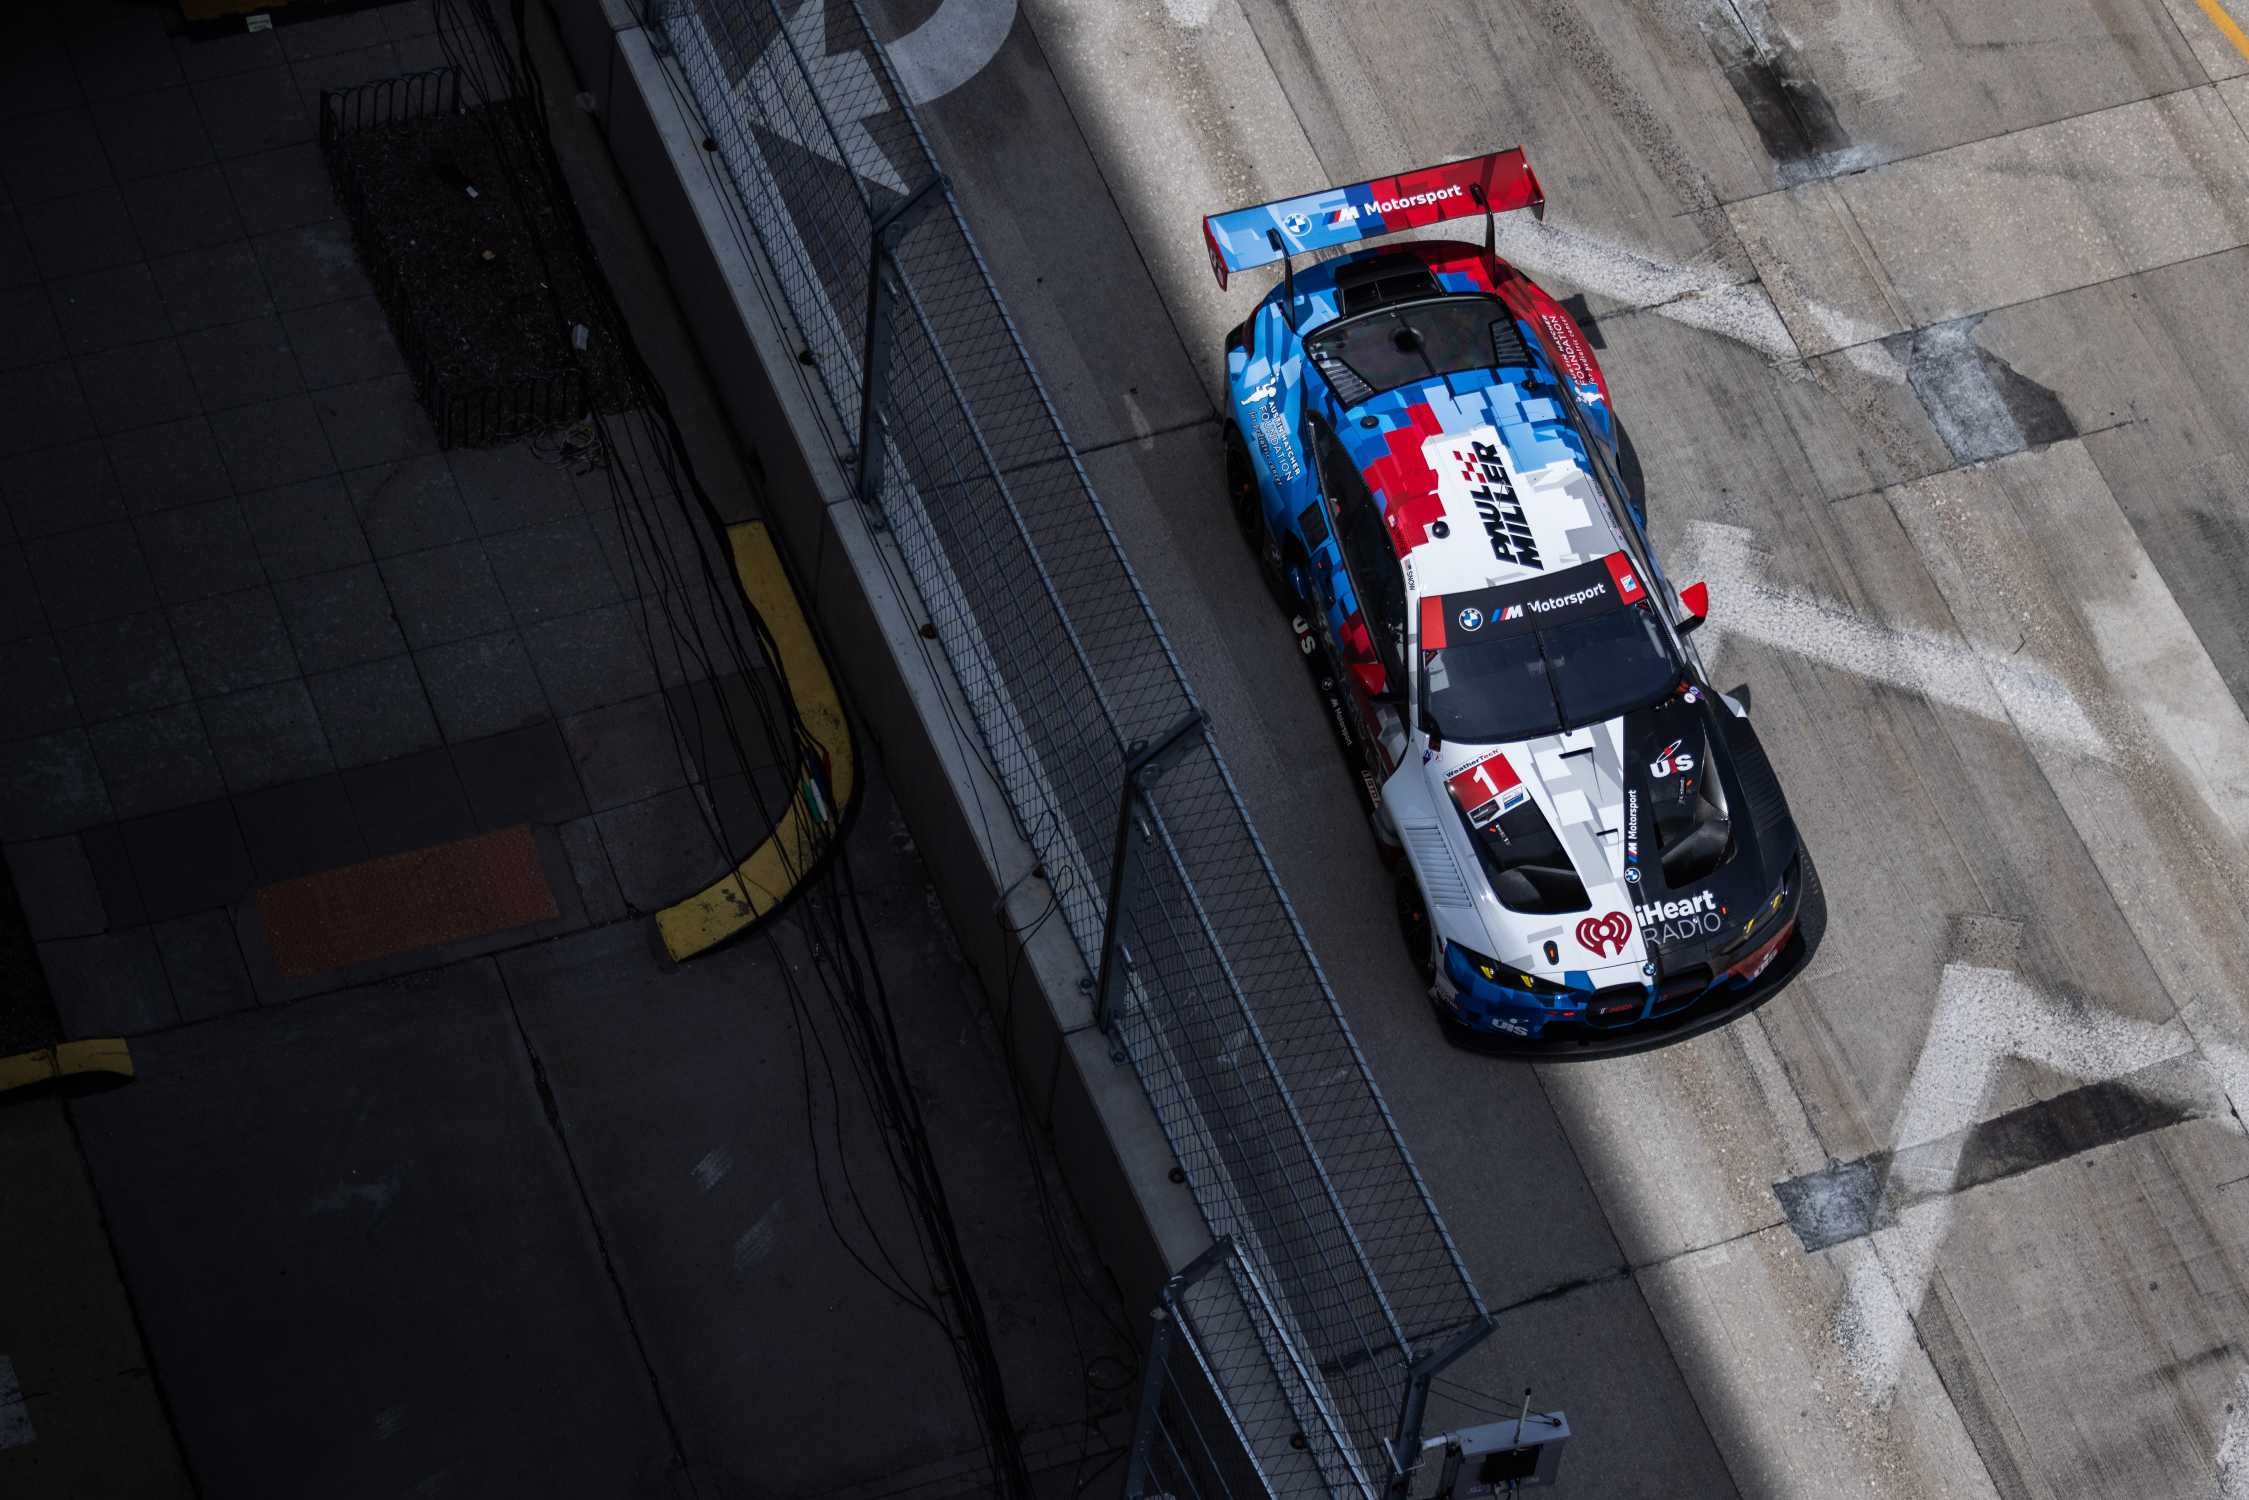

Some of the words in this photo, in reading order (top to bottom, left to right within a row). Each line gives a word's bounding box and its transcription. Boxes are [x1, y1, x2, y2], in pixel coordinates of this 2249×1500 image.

[1364, 184, 1463, 217] Motorsport
[1259, 405, 1294, 481] FOUNDATION
[1268, 400, 1286, 432] AUSTIN
[1281, 434, 1301, 476] HATCHER
[1471, 440, 1545, 571] MILLER
[1470, 485, 1519, 565] PAUL
[1406, 570, 1416, 591] SNOW
[1527, 582, 1606, 614] Motorsport
[1472, 764, 1500, 796] 1
[1627, 789, 1639, 840] Motorsport
[1634, 889, 1717, 927] iHeart
[1641, 911, 1721, 949] RADIO
